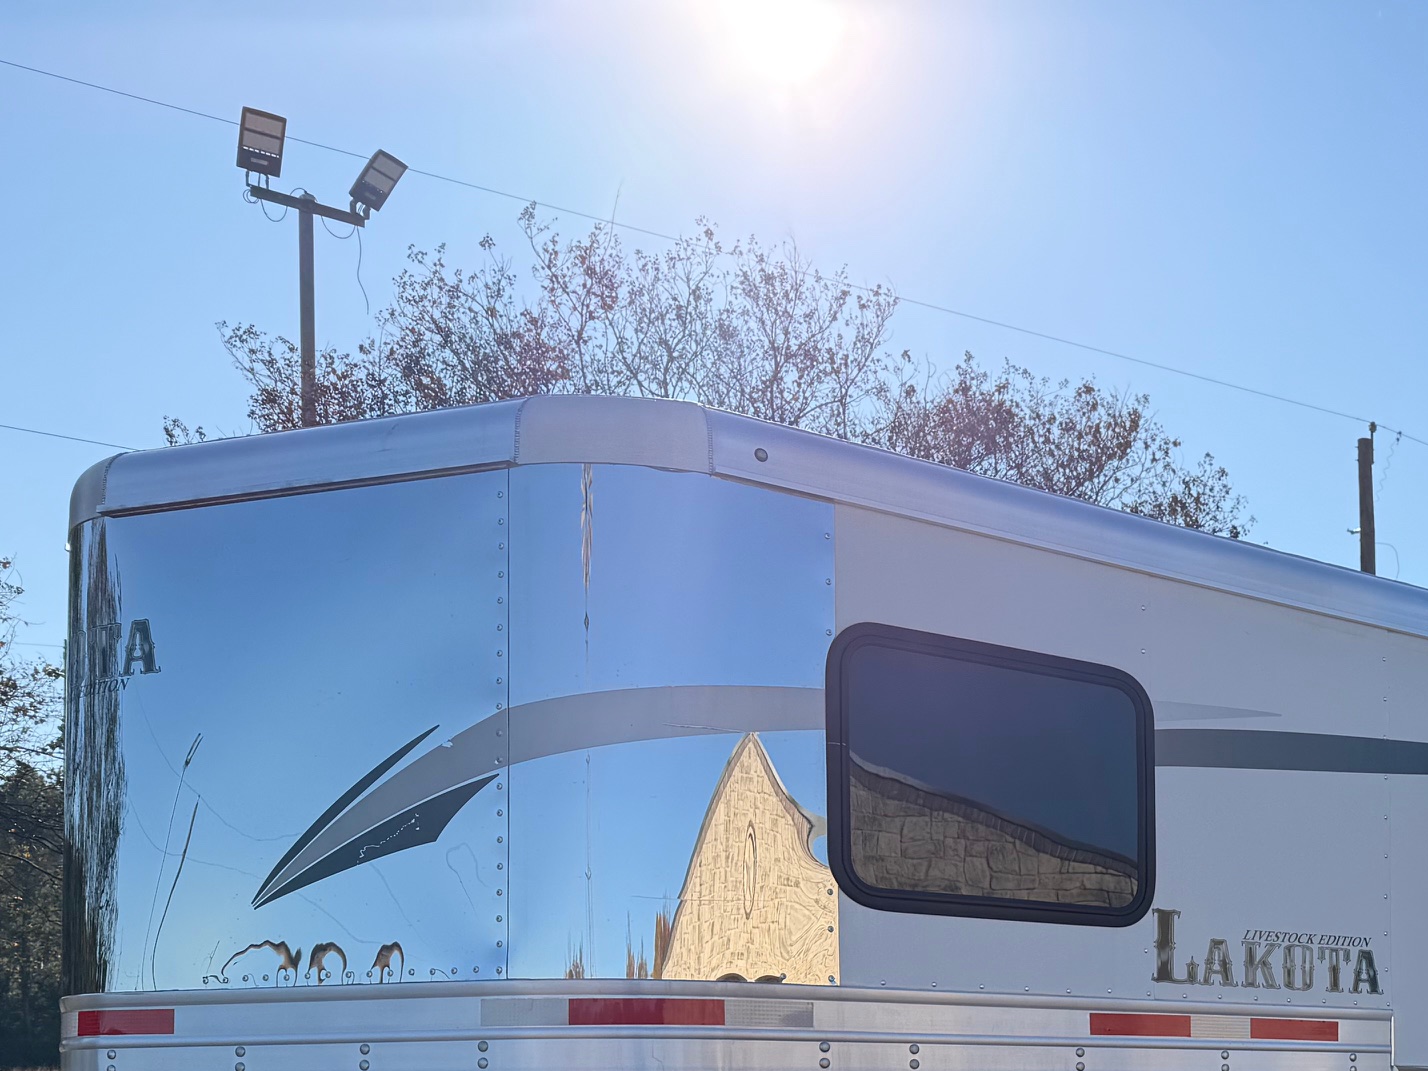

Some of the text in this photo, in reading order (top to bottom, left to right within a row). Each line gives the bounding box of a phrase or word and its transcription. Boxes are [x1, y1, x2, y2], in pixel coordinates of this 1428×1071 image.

[1151, 907, 1384, 995] LAKOTA
[1242, 929, 1372, 948] LIVESTOCK EDITION
